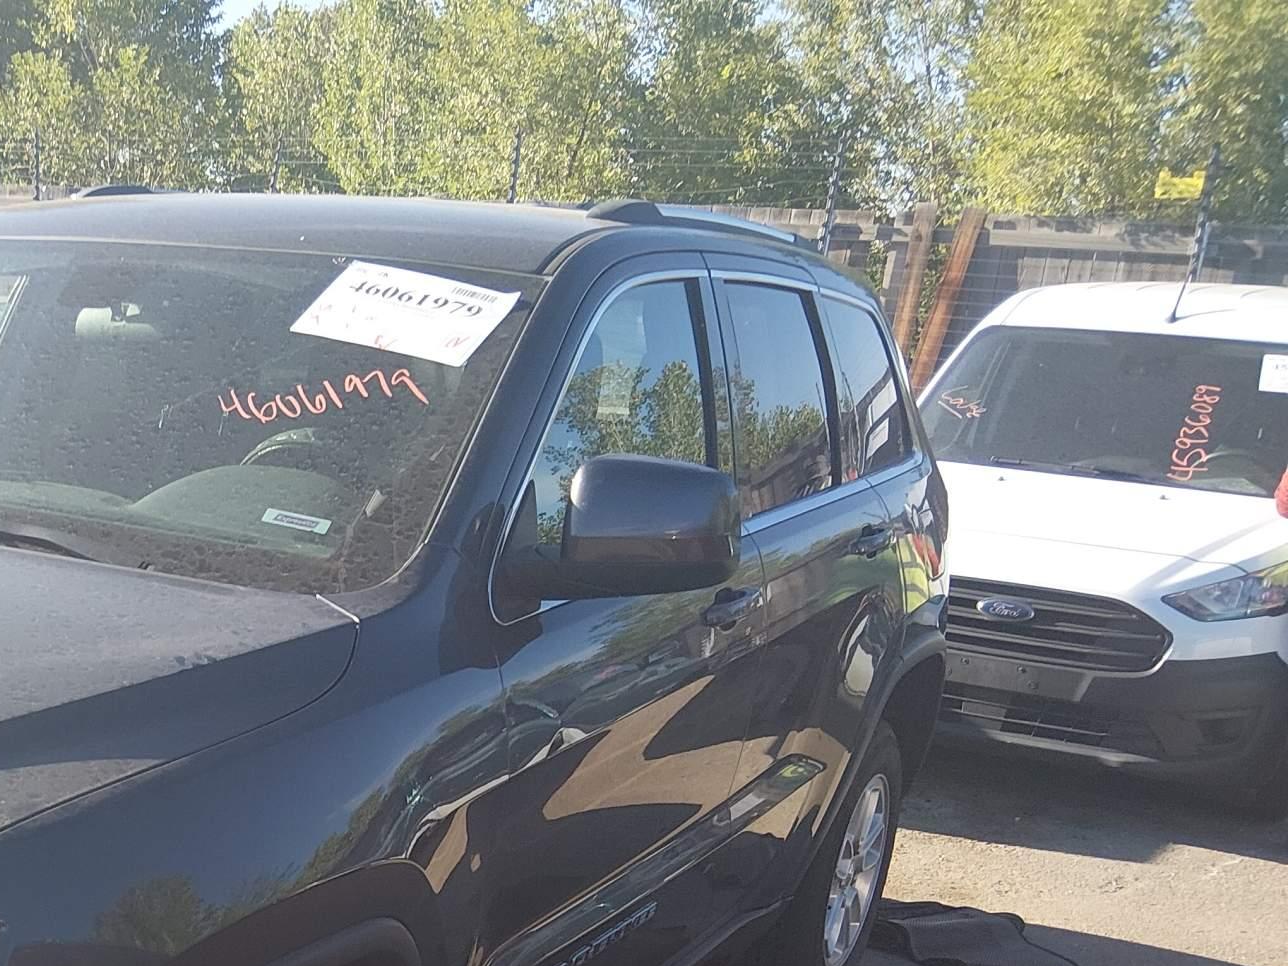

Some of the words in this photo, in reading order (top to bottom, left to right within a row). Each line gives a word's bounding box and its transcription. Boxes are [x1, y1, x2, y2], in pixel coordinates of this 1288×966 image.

[349, 280, 484, 318] 46061979
[217, 368, 430, 424] 46061979
[1166, 384, 1222, 481] 45936089
[988, 601, 1022, 618] Ford
